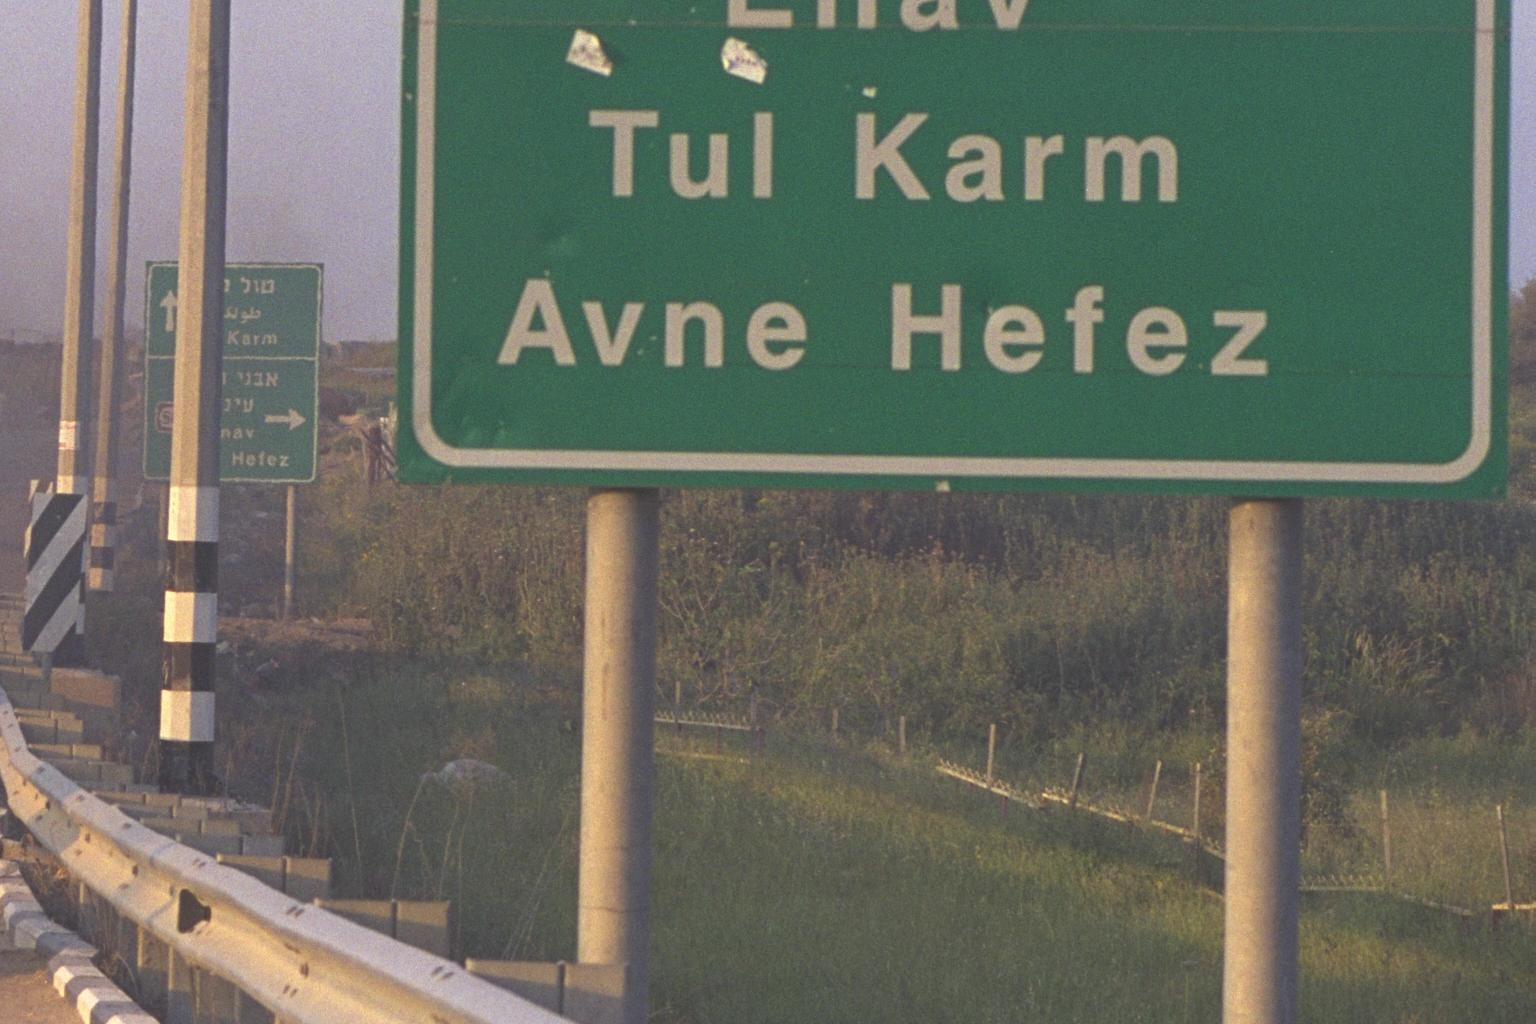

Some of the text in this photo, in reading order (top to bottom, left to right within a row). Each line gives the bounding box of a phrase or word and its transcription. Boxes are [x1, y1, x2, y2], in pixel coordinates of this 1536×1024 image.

[589, 110, 1178, 203] Tul Karm
[498, 279, 1268, 375] Avne Hefez
[227, 330, 278, 345] Karm
[220, 428, 255, 440] nav
[231, 450, 290, 467] Hefez
